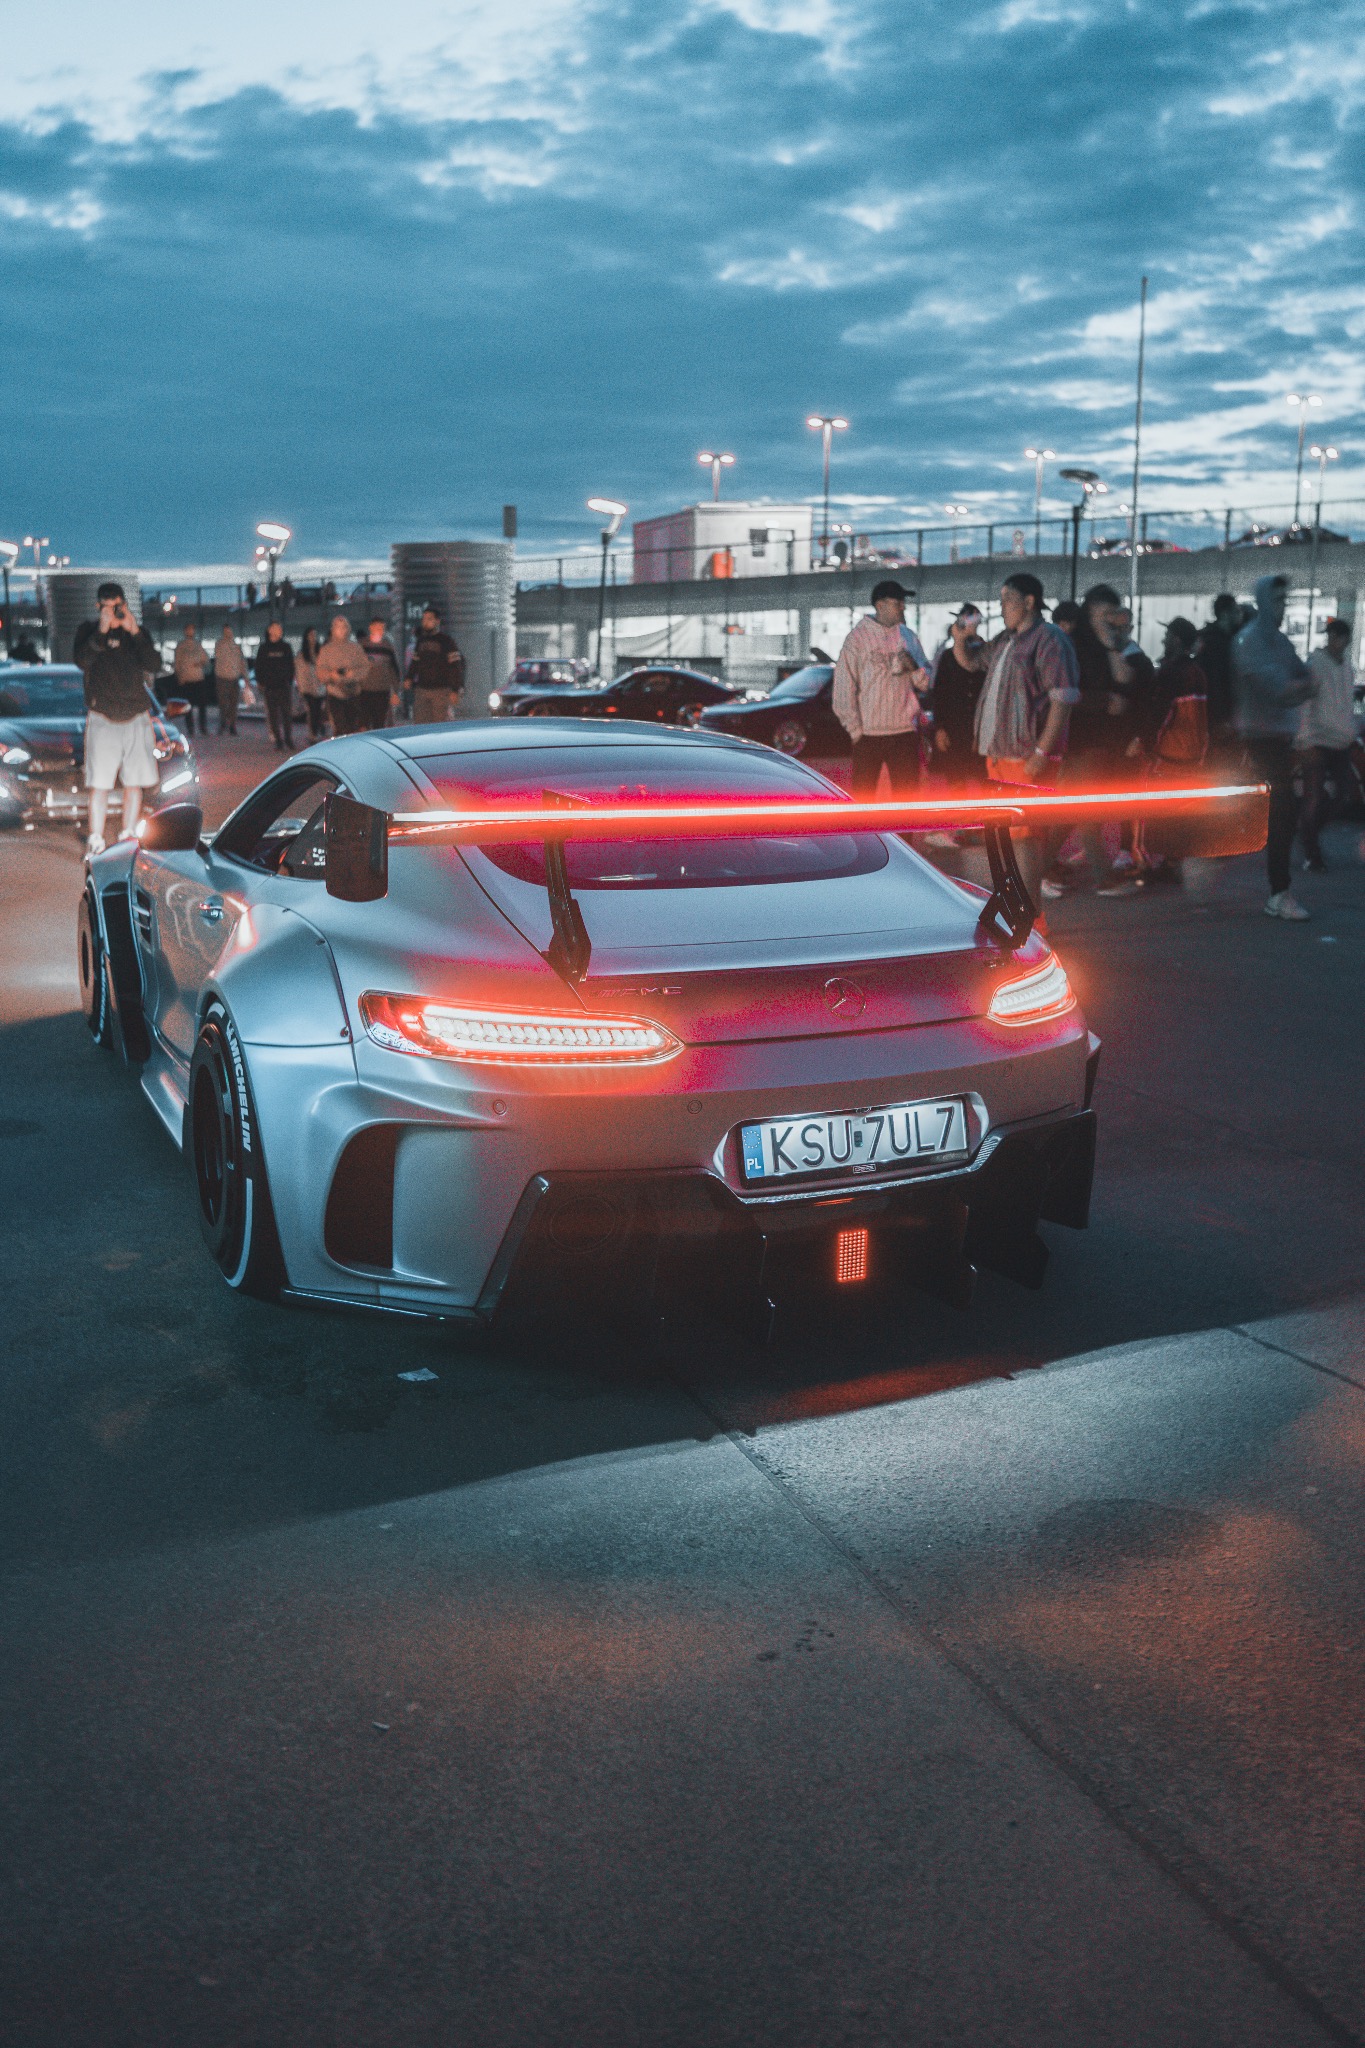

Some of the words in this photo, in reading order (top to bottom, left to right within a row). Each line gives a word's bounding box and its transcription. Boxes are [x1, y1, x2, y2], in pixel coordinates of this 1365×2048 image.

[229, 1037, 252, 1153] MICHELIN
[746, 1157, 762, 1171] PL
[770, 1119, 853, 1172] KSU
[862, 1106, 956, 1160] 7UL7
